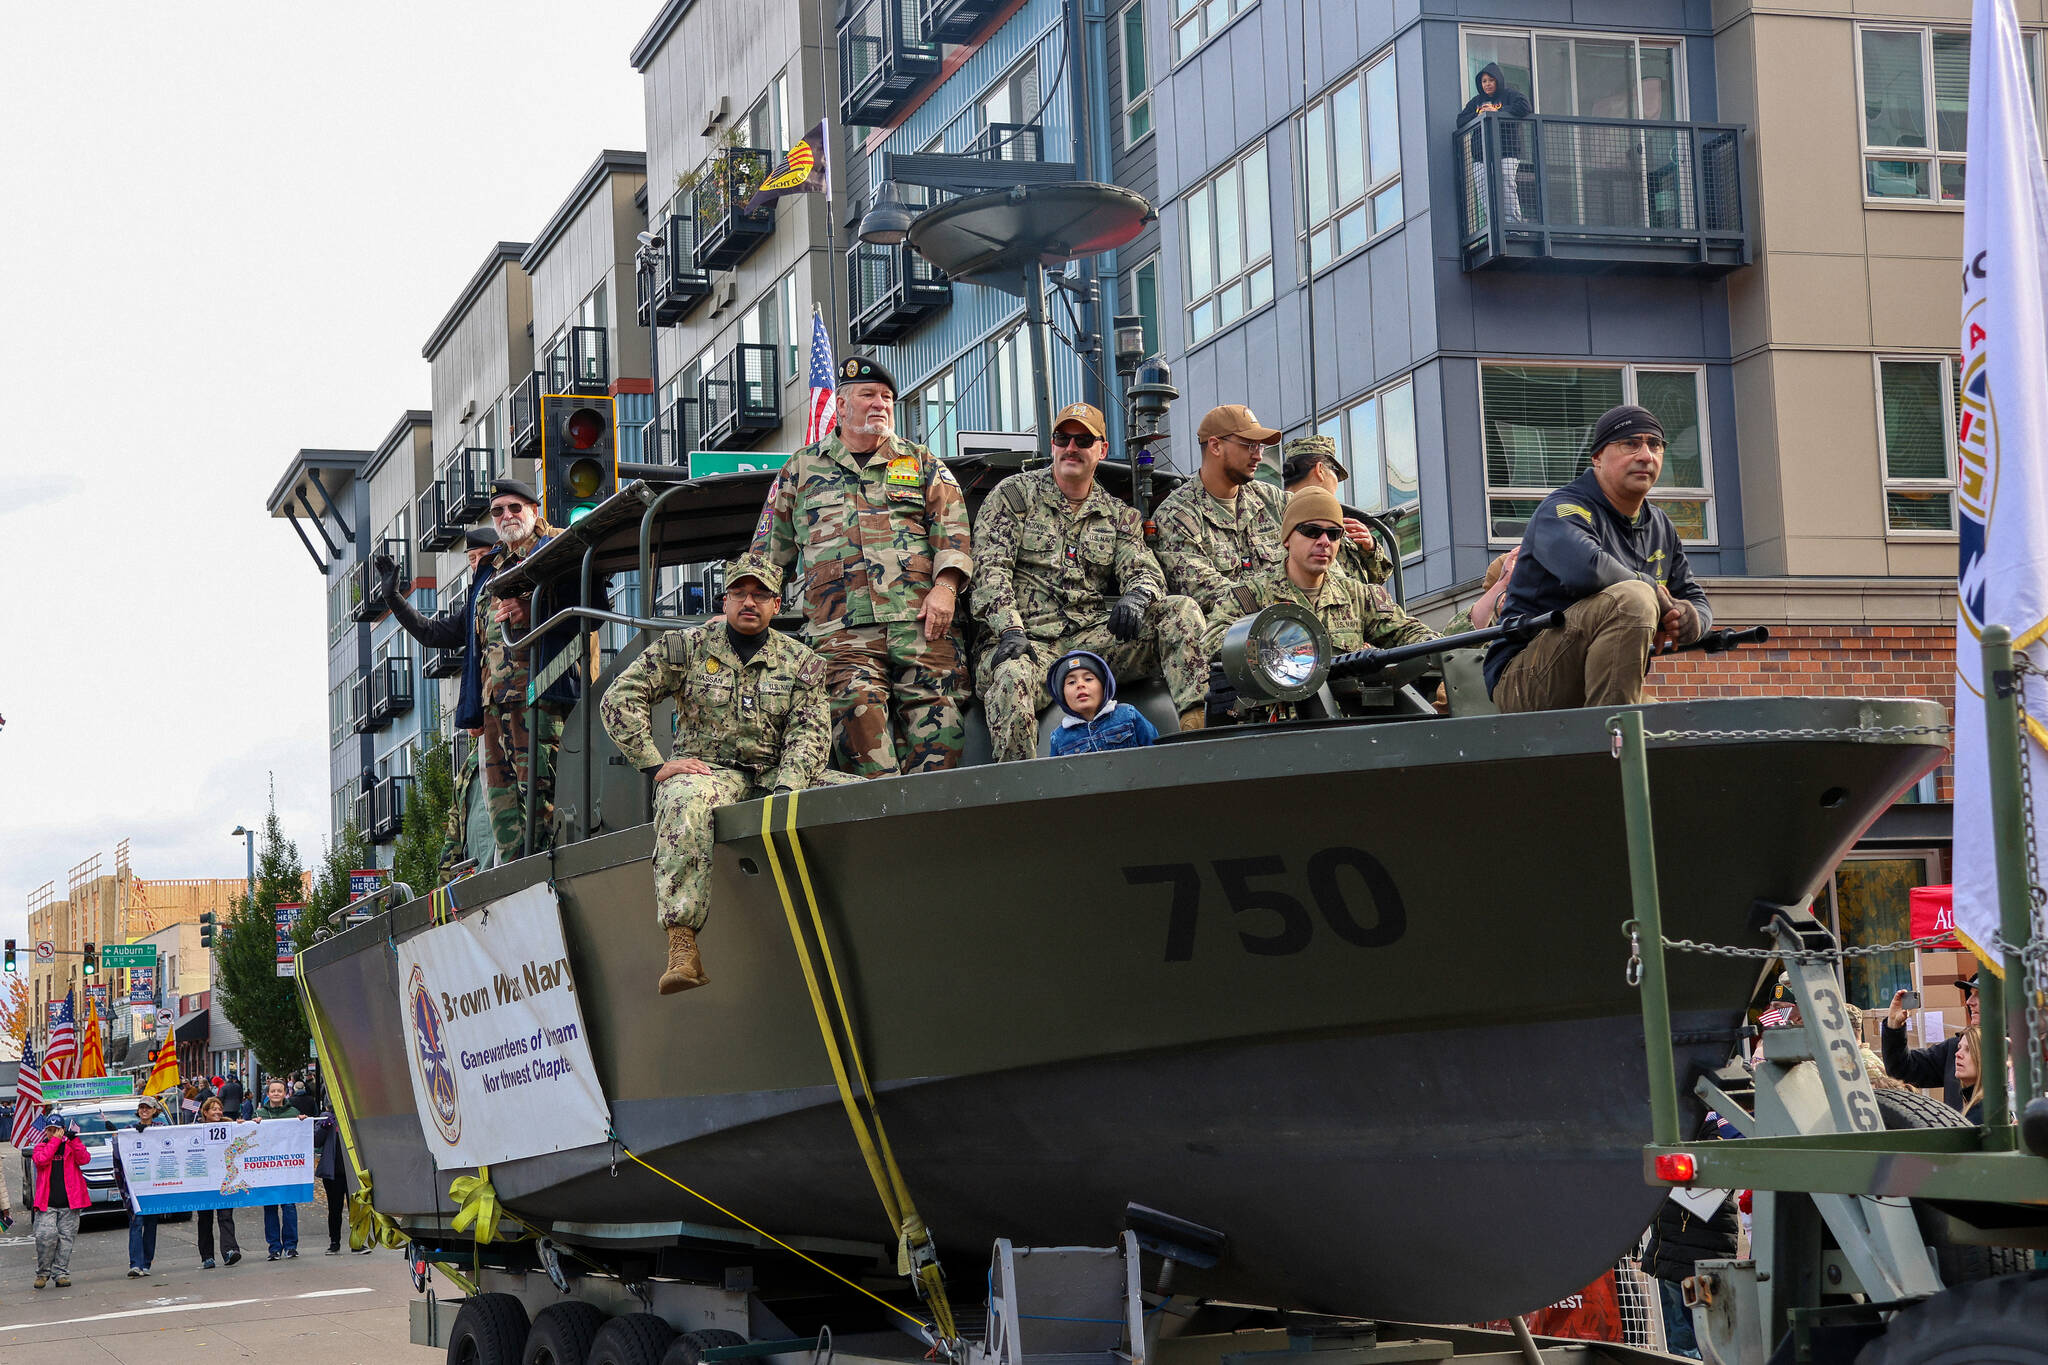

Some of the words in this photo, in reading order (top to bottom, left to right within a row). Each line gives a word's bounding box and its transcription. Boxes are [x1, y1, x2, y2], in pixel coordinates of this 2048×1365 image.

[696, 674, 723, 685] HASSAN
[351, 882, 381, 890] HEROE
[1121, 846, 1407, 962] 750
[113, 946, 144, 956] Auburn
[105, 958, 111, 967] A
[441, 987, 491, 1023] Brown
[522, 958, 575, 997] Navy
[530, 1028, 542, 1051] of
[482, 1061, 532, 1094] Northwest
[532, 1053, 574, 1081] Chapte
[209, 1127, 227, 1140] 128
[244, 1154, 289, 1163] REDEFINING
[244, 1159, 305, 1170] FOUNDATION
